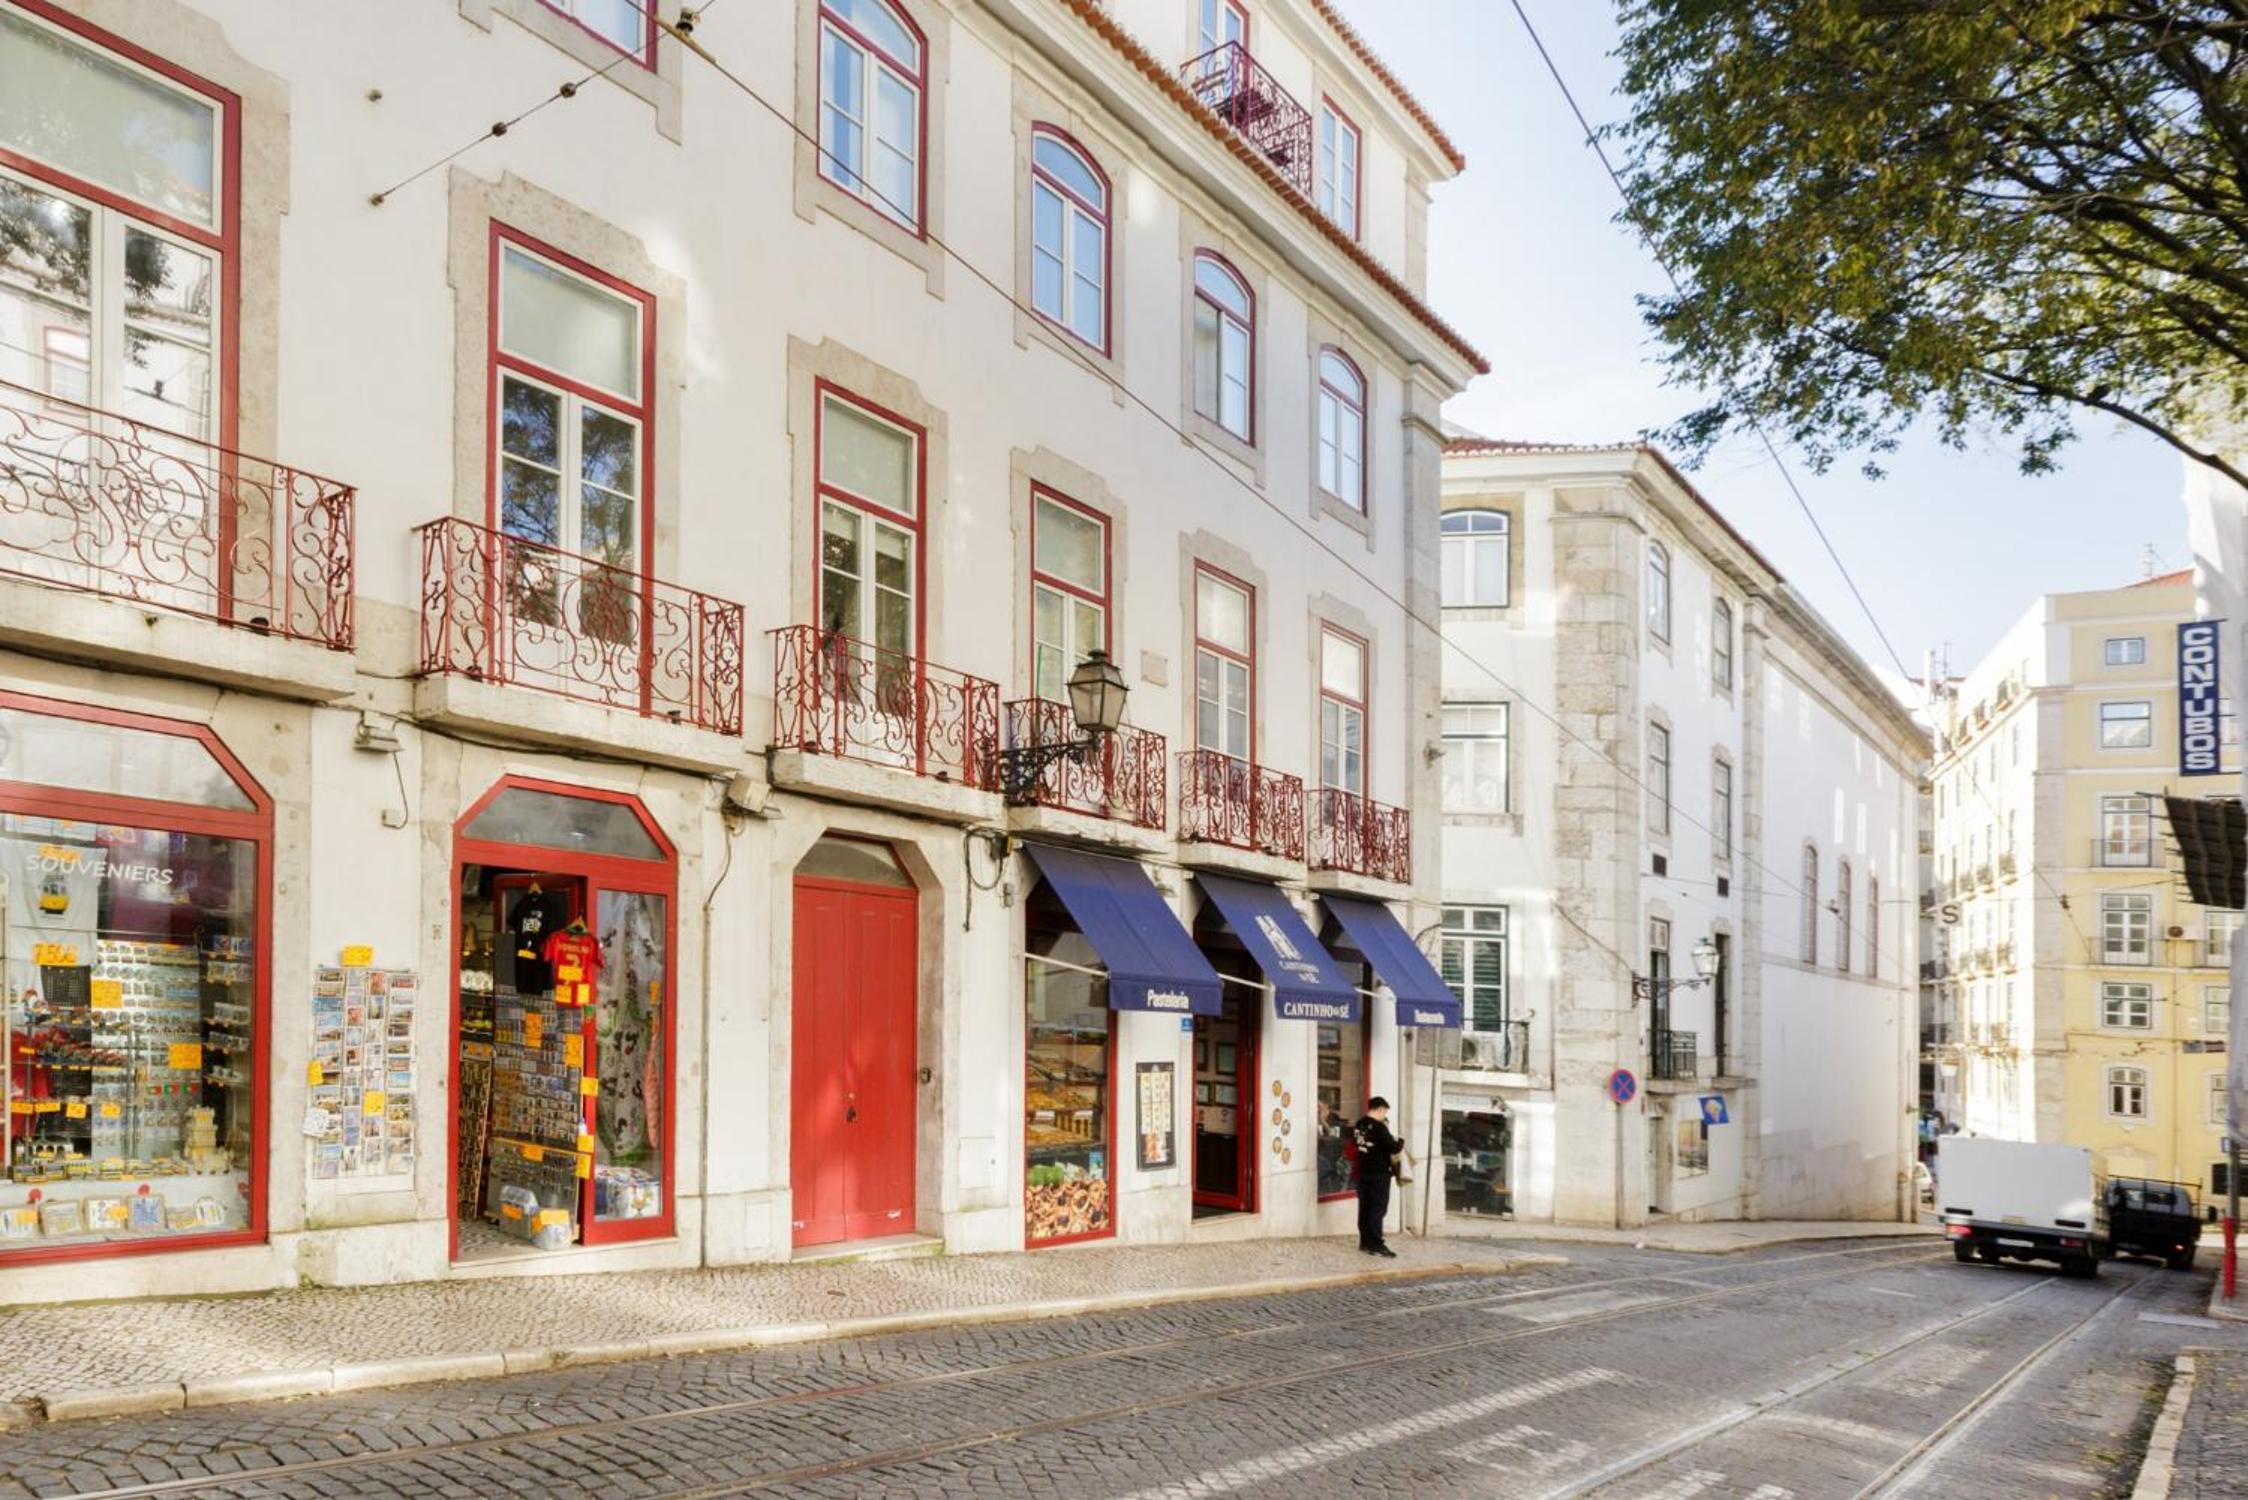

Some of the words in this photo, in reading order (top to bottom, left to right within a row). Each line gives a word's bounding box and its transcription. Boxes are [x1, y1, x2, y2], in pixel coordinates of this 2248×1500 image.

[2182, 627, 2215, 770] CONTUBOS
[26, 853, 174, 885] SOUVENIERS
[1941, 904, 1959, 924] S
[1283, 1002, 1333, 1018] CANTINHO
